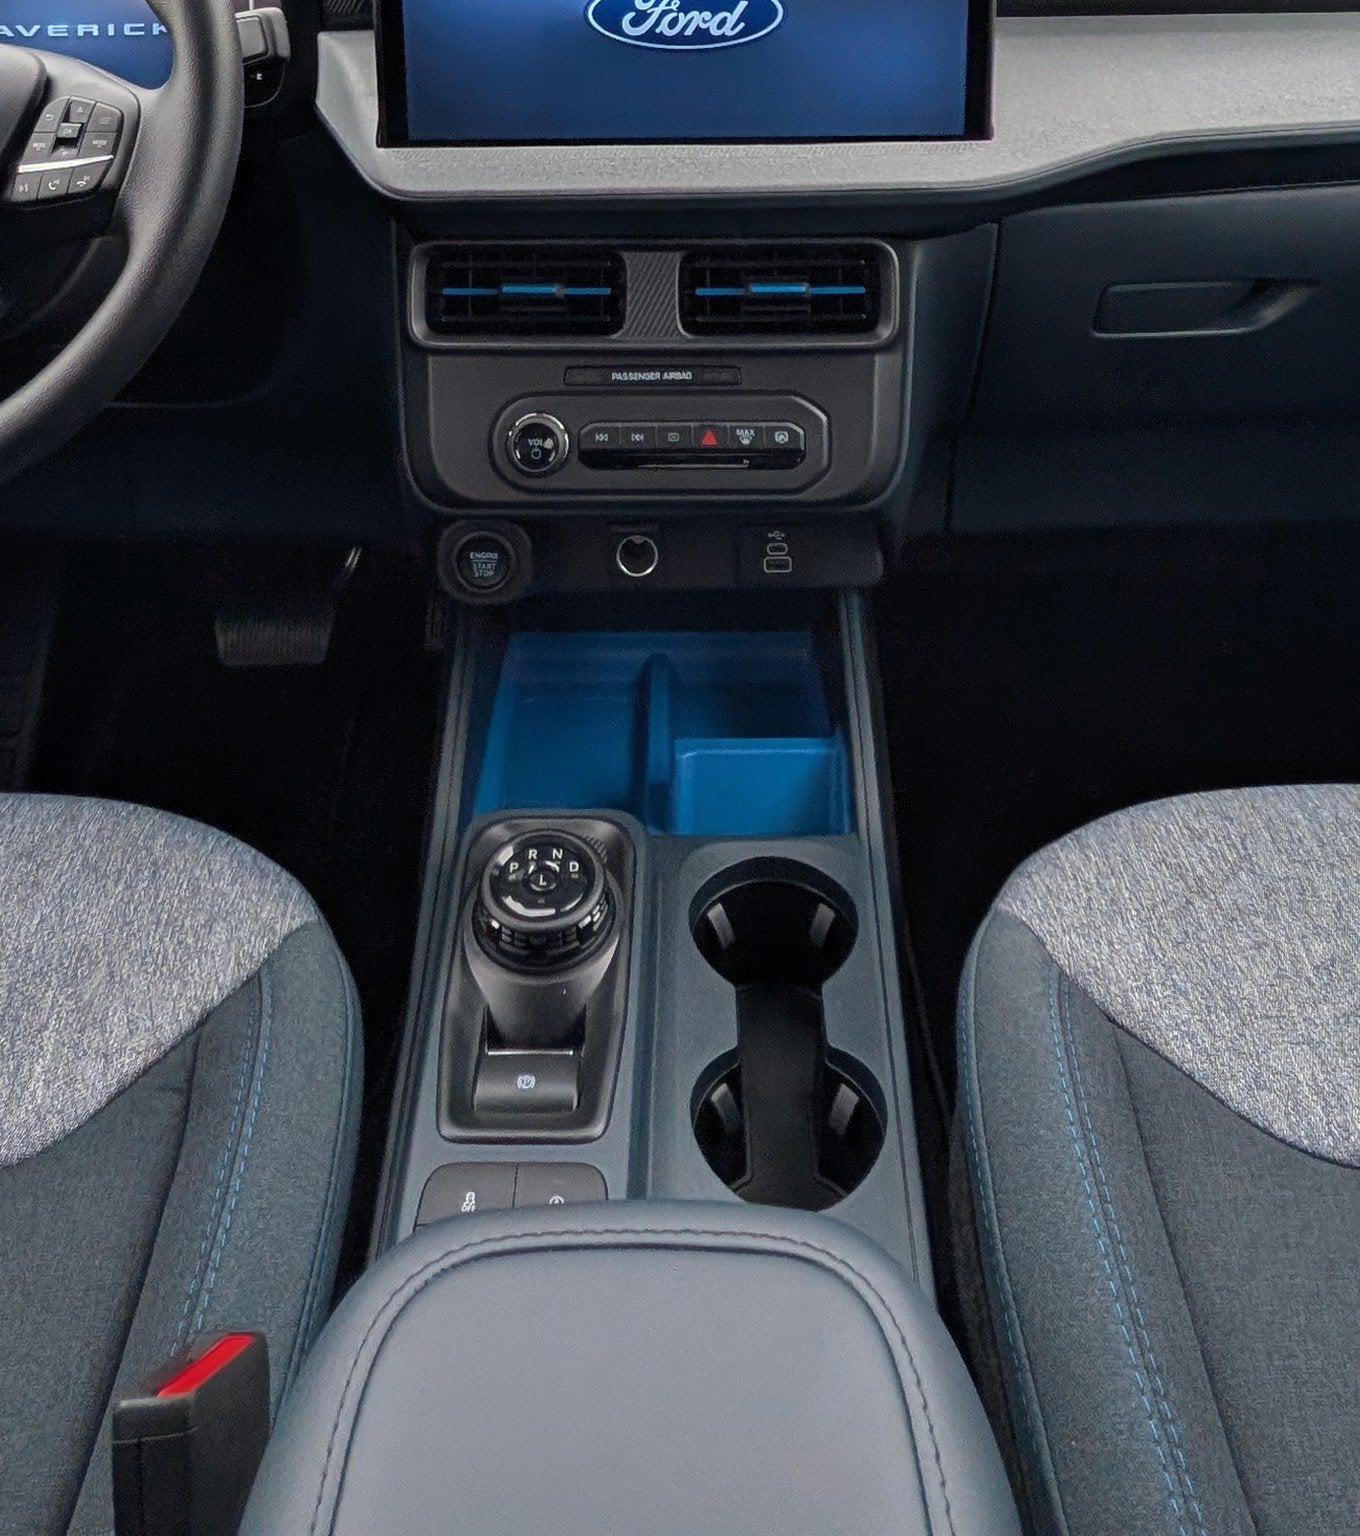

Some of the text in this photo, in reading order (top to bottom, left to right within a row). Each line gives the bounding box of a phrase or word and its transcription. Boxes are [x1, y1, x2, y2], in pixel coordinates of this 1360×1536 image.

[611, 370, 692, 381] PASSENGER AIRBAG
[510, 849, 579, 873] P R N D
[540, 875, 547, 886] L
